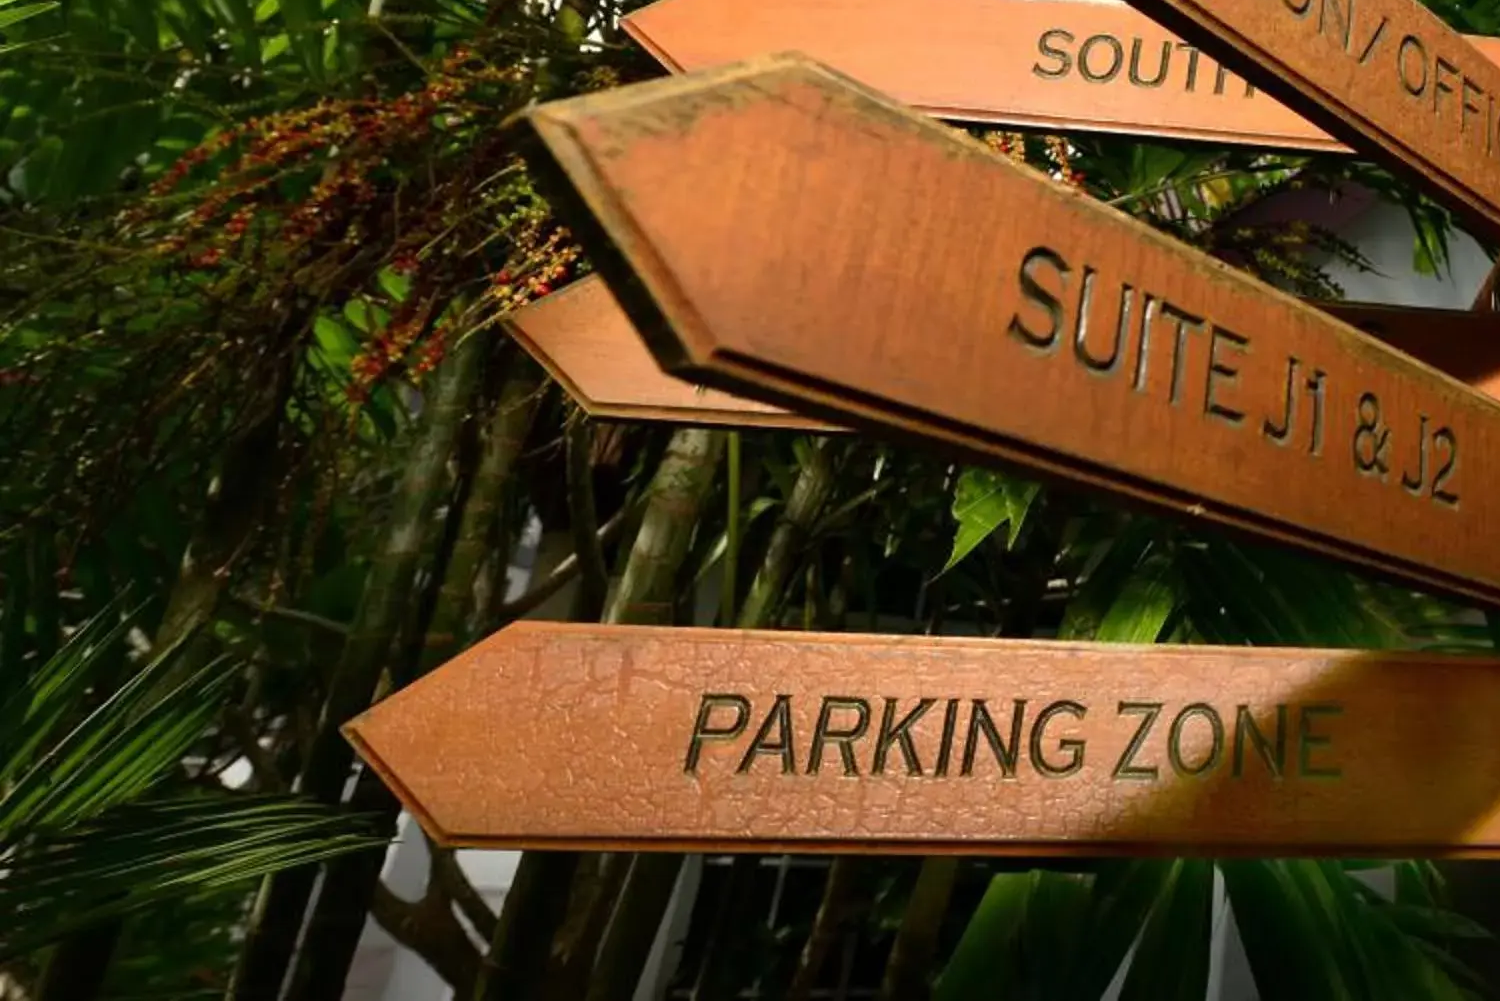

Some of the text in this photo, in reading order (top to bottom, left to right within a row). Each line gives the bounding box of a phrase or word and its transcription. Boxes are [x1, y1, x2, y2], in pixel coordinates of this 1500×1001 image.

[1007, 245, 1460, 511] SUITE J1 & J2
[683, 693, 1345, 782] PARKING ZONE
